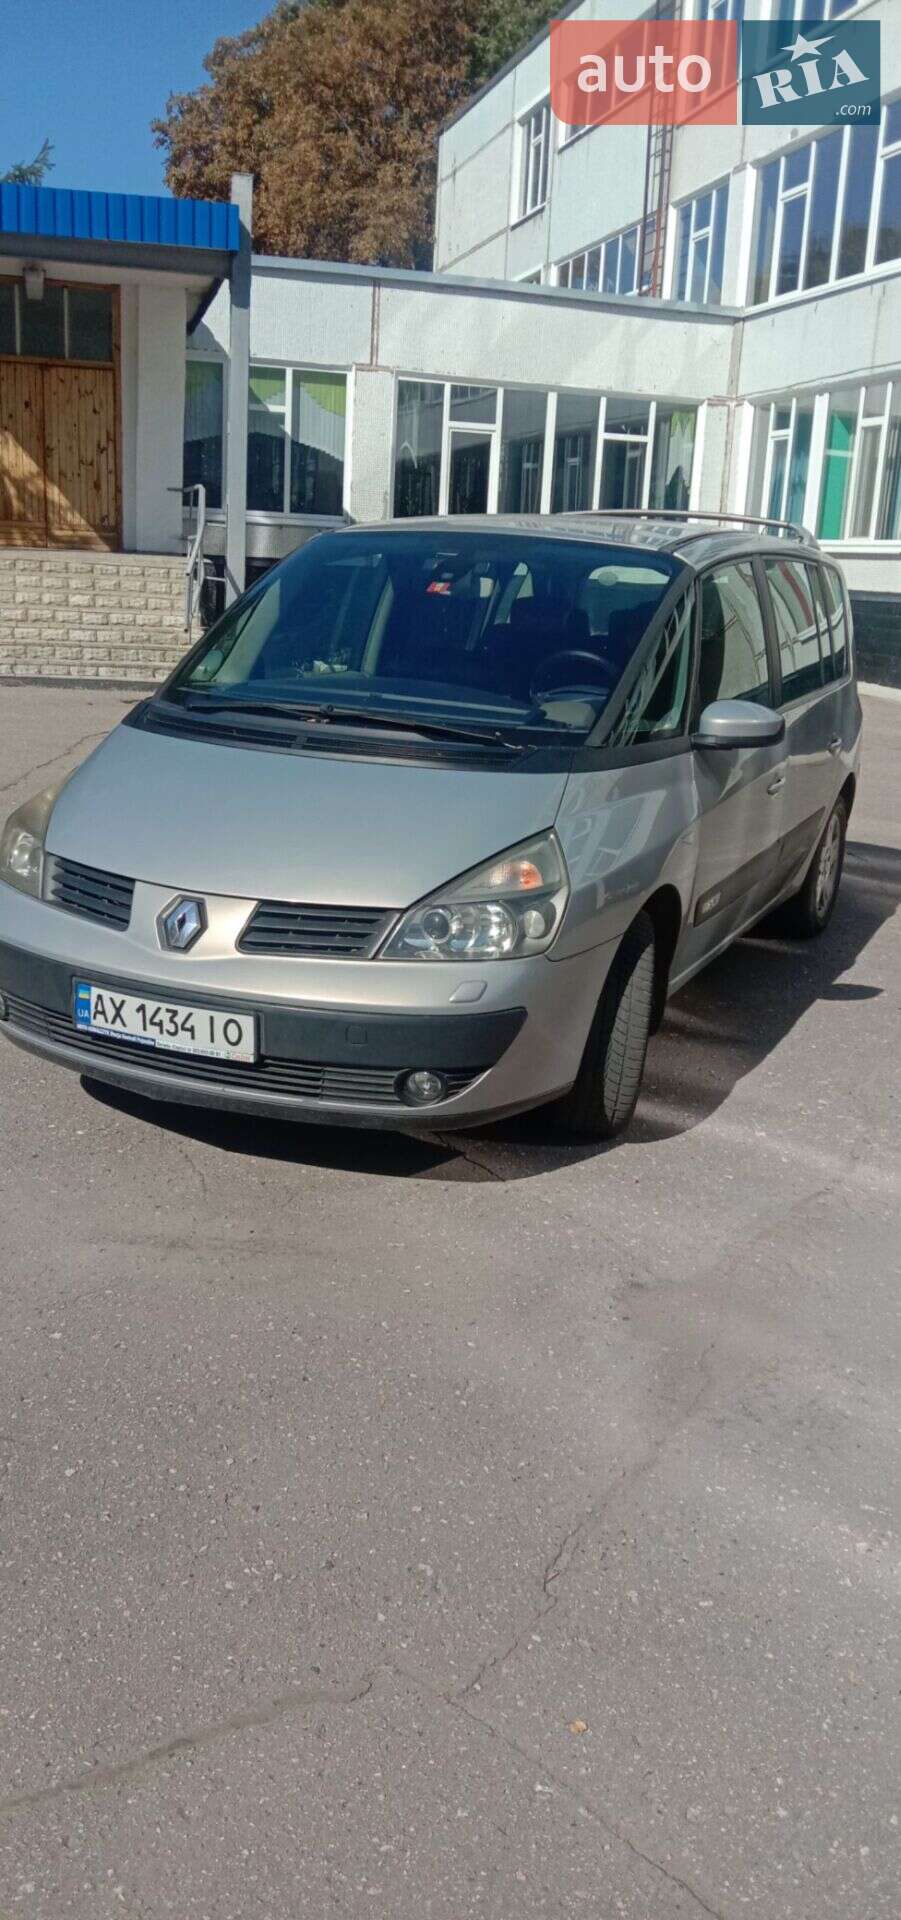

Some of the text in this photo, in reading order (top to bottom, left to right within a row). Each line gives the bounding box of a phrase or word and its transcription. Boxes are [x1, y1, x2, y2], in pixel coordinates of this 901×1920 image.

[77, 1009, 89, 1018] UA
[93, 994, 127, 1028] AX
[135, 1003, 195, 1040] 1434
